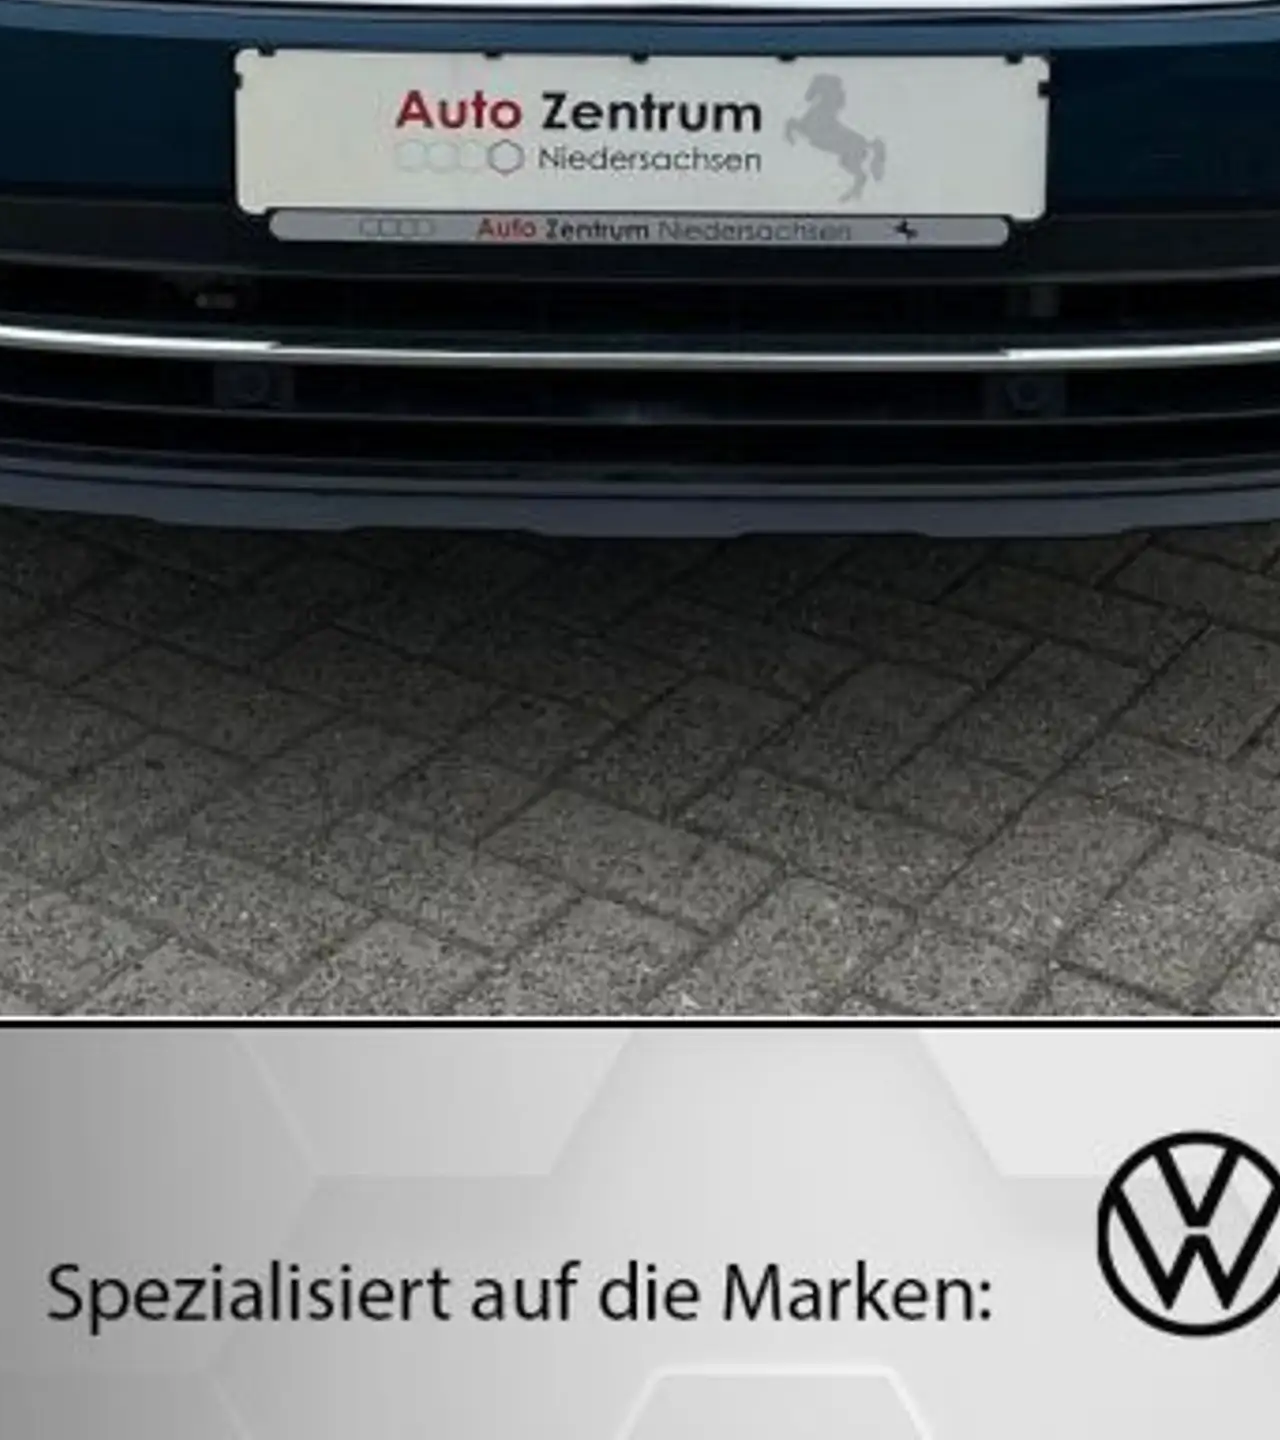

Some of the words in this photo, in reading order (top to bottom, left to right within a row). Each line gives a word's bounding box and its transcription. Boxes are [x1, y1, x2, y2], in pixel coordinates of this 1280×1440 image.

[394, 90, 524, 132] Auto
[540, 91, 763, 133] Zentrum
[537, 143, 763, 175] Niedersachsen
[476, 216, 537, 241] Auto
[544, 216, 651, 242] Zentrum
[658, 216, 853, 244] Niedersachsen
